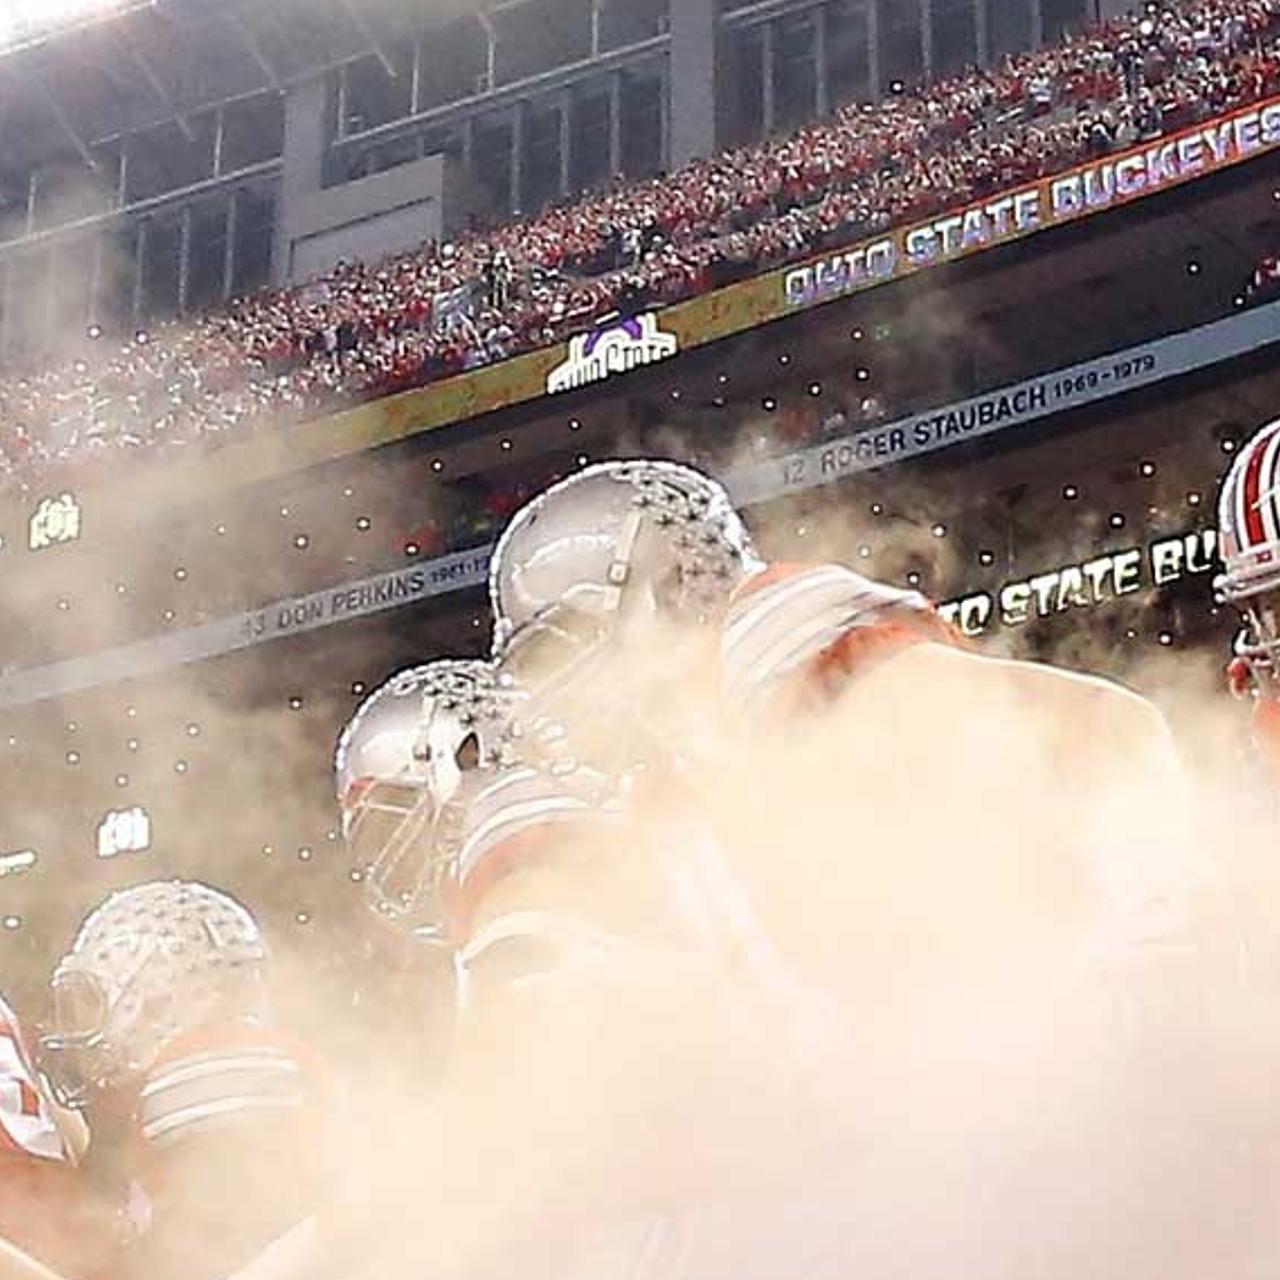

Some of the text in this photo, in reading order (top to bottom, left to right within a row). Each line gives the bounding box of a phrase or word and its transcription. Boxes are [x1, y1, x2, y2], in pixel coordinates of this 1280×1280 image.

[905, 191, 1040, 264] STATE
[821, 430, 906, 476] ROGER
[913, 383, 1047, 447] STAUBACH
[1054, 354, 1155, 399] 1969-1979
[331, 571, 424, 615] PERKINS
[1001, 549, 1141, 624] STATE
